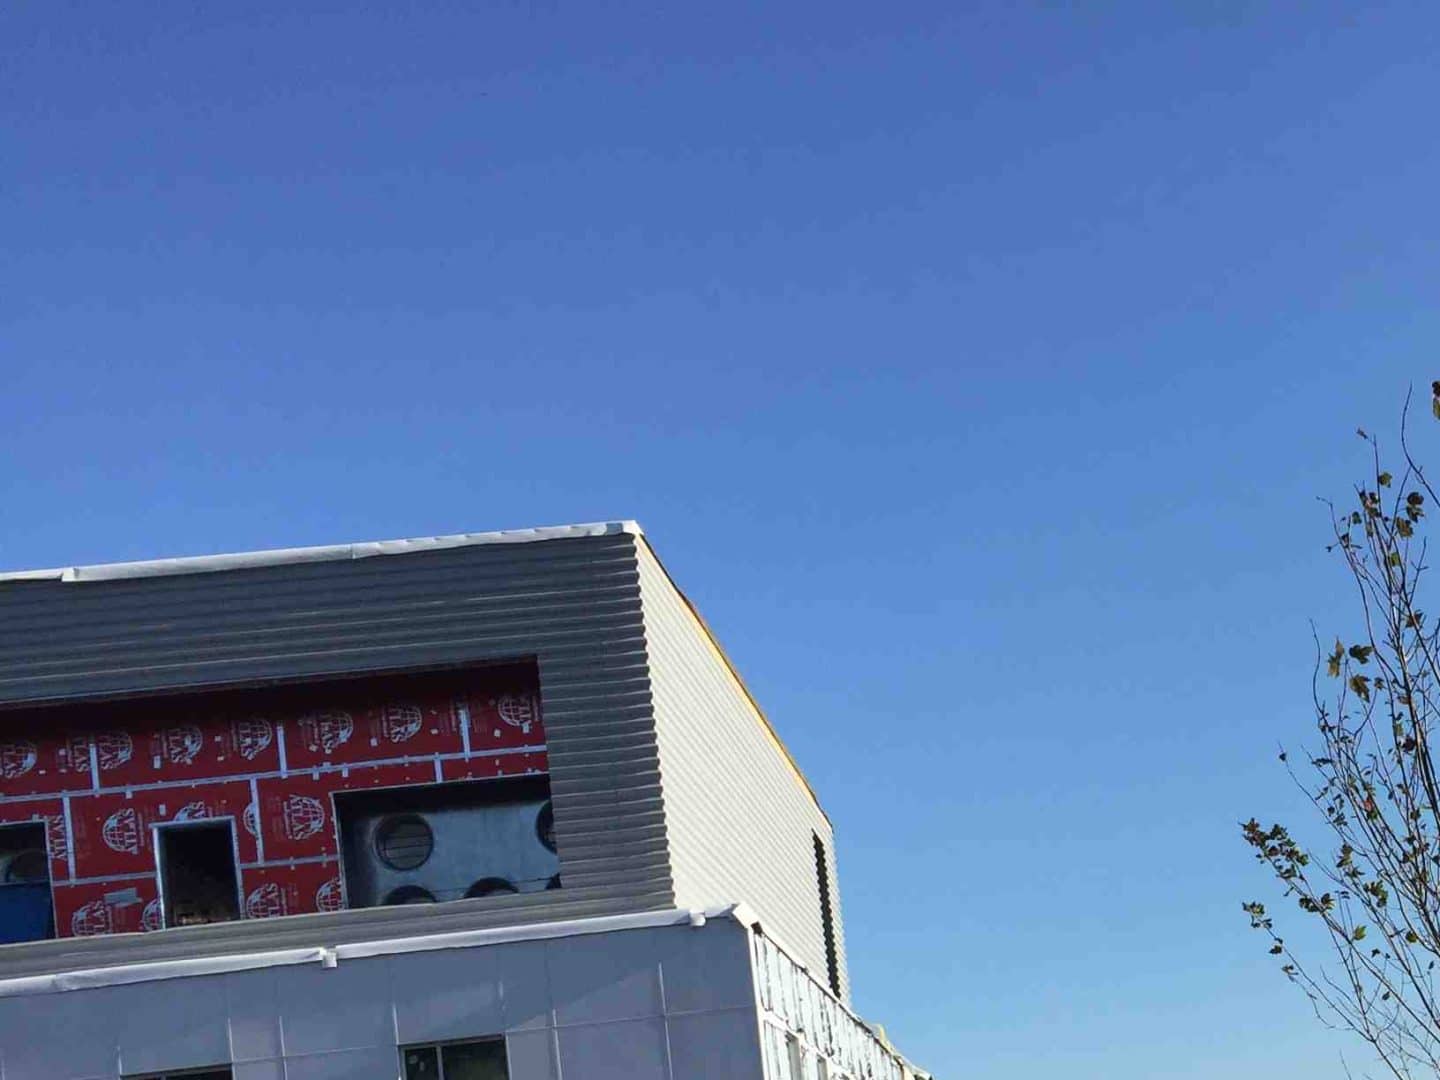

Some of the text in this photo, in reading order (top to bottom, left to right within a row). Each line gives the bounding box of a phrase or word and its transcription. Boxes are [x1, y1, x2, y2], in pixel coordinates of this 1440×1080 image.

[2, 741, 17, 779] TLAS
[289, 794, 306, 841] ATLAS
[265, 883, 280, 915] LAS
